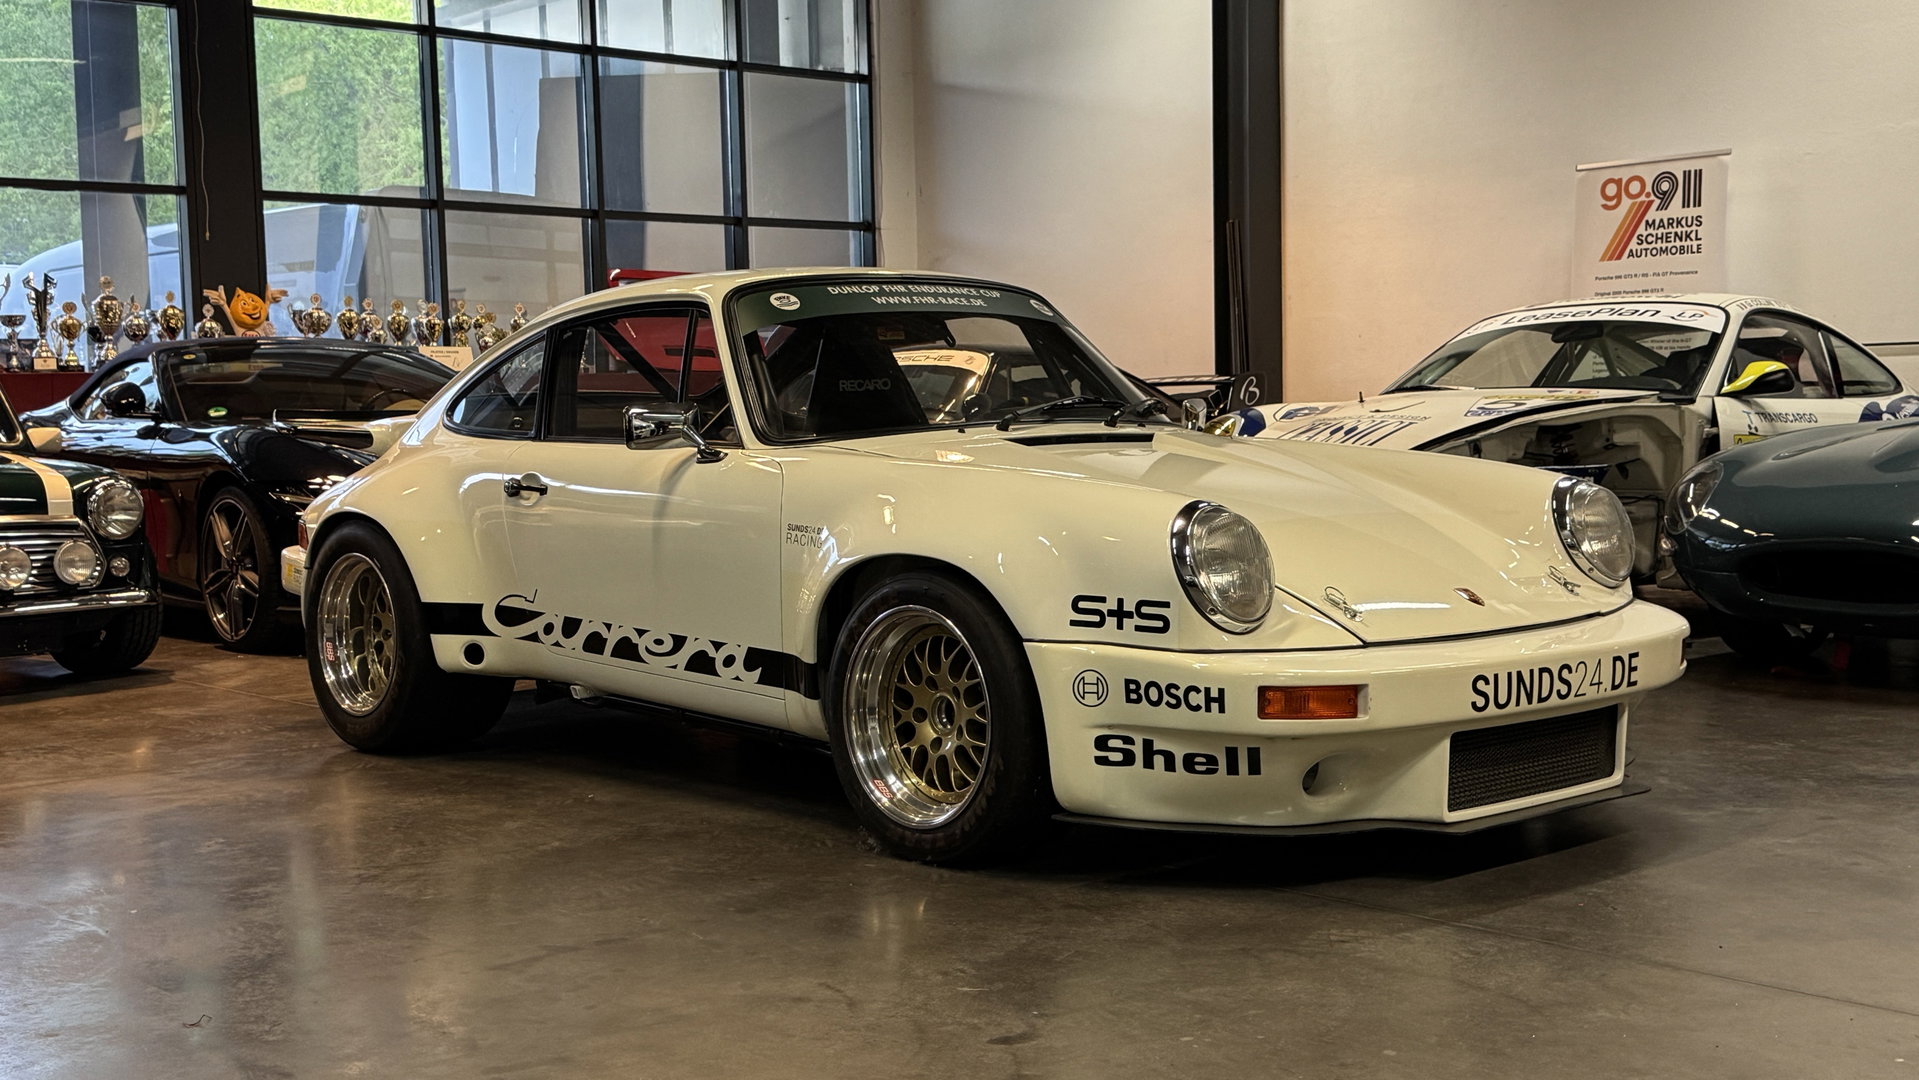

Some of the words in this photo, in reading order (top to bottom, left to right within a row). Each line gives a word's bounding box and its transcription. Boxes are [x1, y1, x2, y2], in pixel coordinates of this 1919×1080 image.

[1644, 215, 1703, 232] MARKUS
[1636, 230, 1702, 246] SCHENKL
[1627, 244, 1702, 259] AUTOMOBILE
[827, 285, 880, 295] DUNLOP
[882, 285, 909, 293] FHR
[909, 284, 980, 296] ENDURANCE
[980, 289, 1001, 298] CUP
[871, 296, 988, 307] WWW.FHR-RACE.DE
[1501, 307, 1661, 325] LeasePlan
[839, 378, 892, 392] RECARO
[1755, 412, 1818, 424] TRANSCARGO
[785, 532, 823, 549] RACING
[1069, 594, 1171, 635] S+S
[482, 588, 762, 684] Carrera
[1471, 652, 1640, 712] SUNDS24.DE
[1124, 678, 1226, 714] BOSCH
[1093, 733, 1262, 777] Shell
[872, 778, 894, 800] BBS
